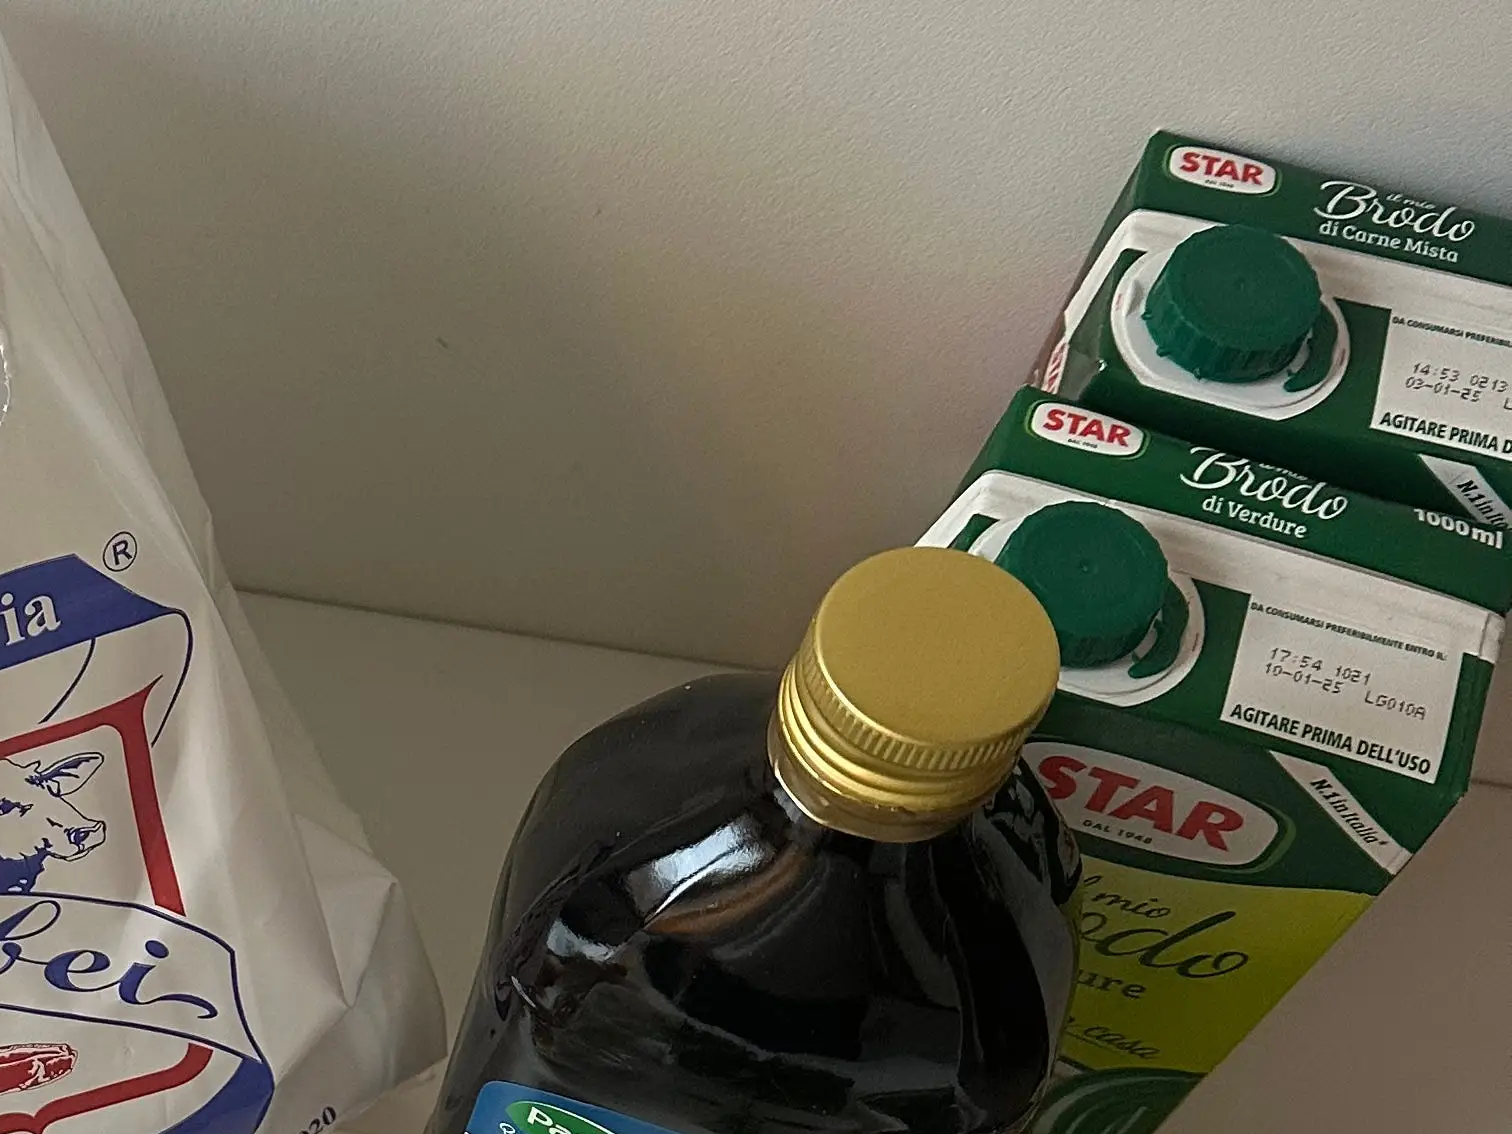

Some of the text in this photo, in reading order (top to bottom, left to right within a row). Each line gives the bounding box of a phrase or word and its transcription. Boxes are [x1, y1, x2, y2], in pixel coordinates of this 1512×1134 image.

[1180, 152, 1264, 186] STAR
[1313, 181, 1475, 242] Brodo
[1319, 221, 1459, 263] di Carne Mista
[1413, 362, 1460, 382] 14:53
[1043, 408, 1131, 448] STAR
[1380, 412, 1446, 439] AGITARE
[1449, 427, 1498, 451] PRIMA
[1179, 446, 1348, 520] Brodo
[1202, 496, 1307, 539] di Verdure
[1250, 602, 1265, 613] DA
[1265, 606, 1324, 629] CONSUMARSI
[1265, 662, 1344, 694] 10-01-25
[1270, 648, 1371, 686] 17:54 1021
[1230, 703, 1431, 775] AGITARE PRIMA DELL'USO
[1036, 754, 1244, 853] STAR
[1310, 778, 1341, 800] N.1
[1083, 819, 1112, 834] DAL
[1081, 911, 1249, 979] odo
